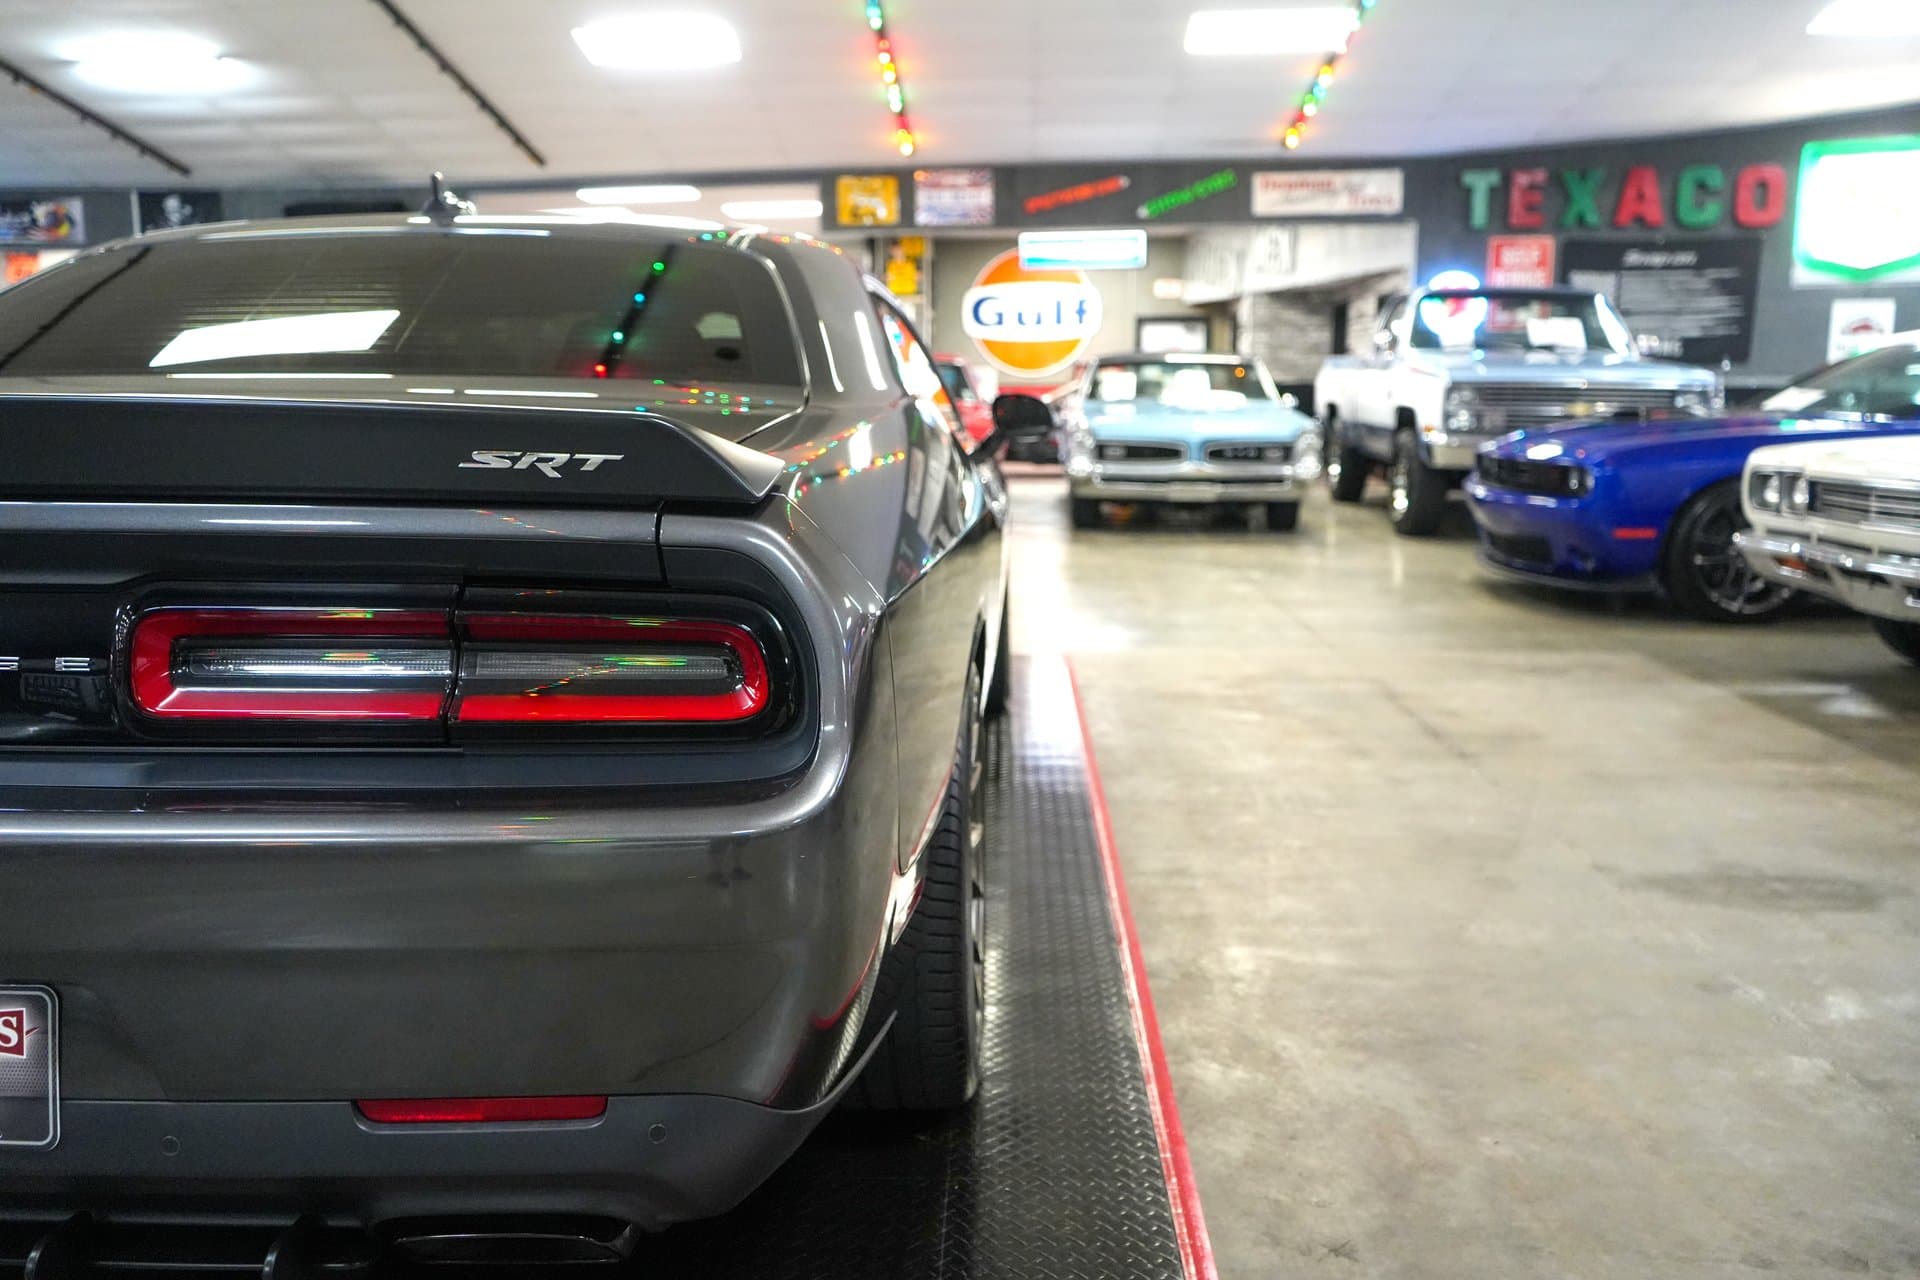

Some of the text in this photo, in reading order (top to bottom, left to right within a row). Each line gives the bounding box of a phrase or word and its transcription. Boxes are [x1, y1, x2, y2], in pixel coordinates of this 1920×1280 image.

[1462, 165, 1787, 229] TEXACO
[972, 297, 1087, 326] Gulf
[458, 450, 625, 478] SRT
